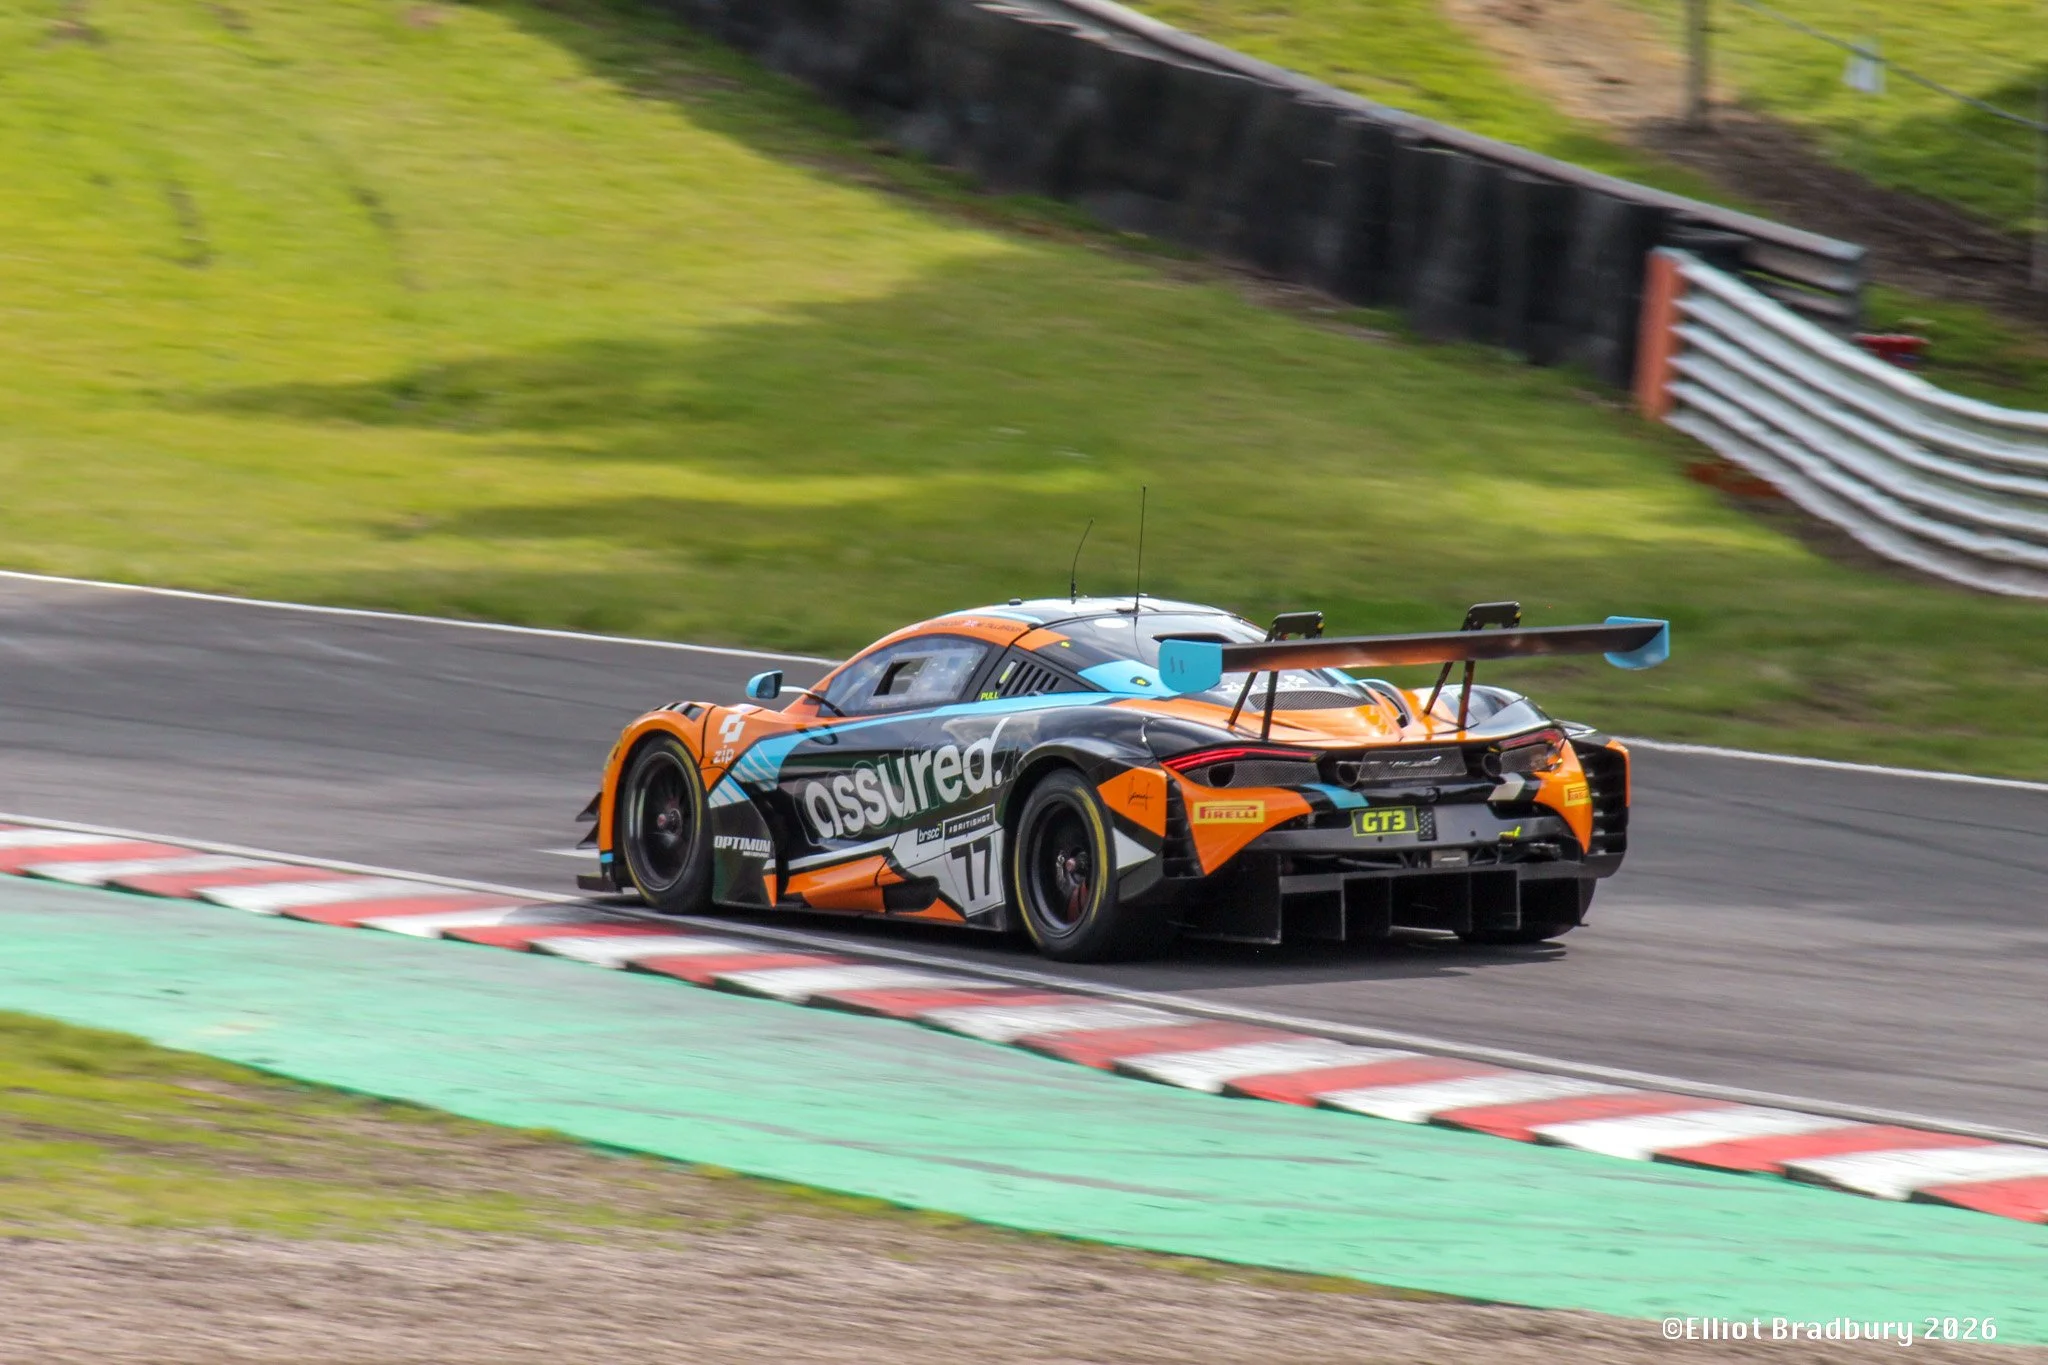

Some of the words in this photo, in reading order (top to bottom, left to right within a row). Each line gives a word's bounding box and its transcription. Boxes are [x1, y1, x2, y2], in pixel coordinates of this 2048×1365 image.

[980, 691, 998, 700] PULL
[713, 745, 735, 764] zip
[1199, 805, 1257, 819] PIRELLI
[1362, 810, 1406, 832] GT3
[919, 827, 940, 842] brscc
[714, 835, 771, 852] OPTIMUM
[951, 836, 992, 902] 77
